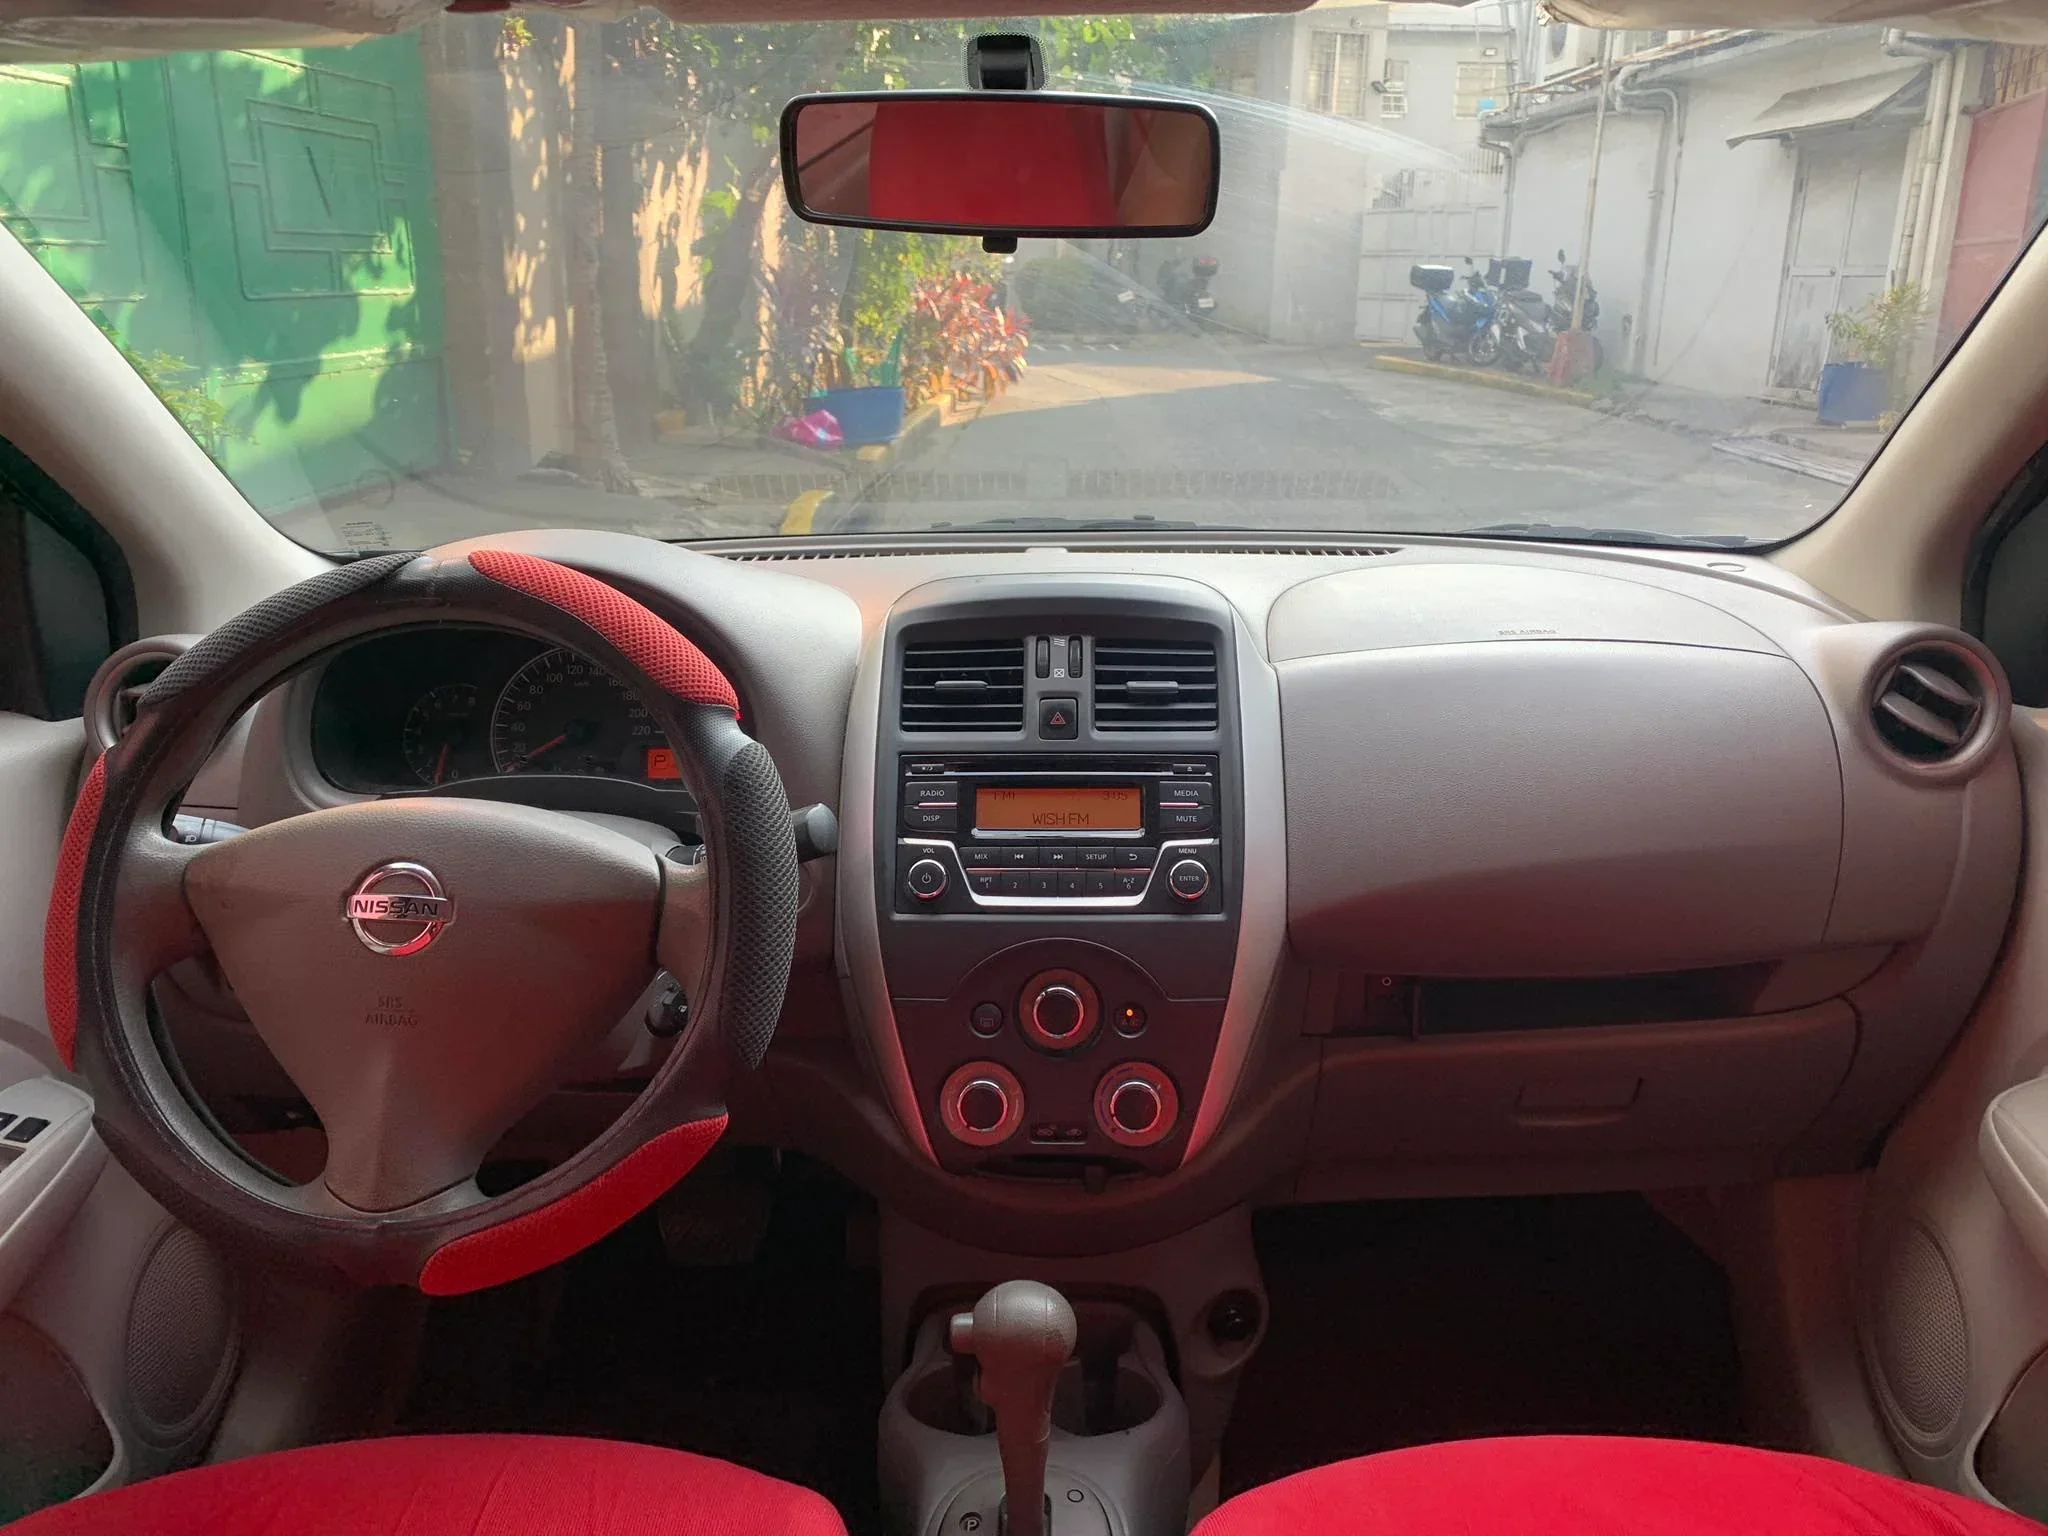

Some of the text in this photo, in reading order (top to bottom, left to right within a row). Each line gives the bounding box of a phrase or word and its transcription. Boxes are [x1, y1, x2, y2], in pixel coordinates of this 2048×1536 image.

[567, 664, 584, 675] 120
[546, 672, 563, 683] 100
[529, 684, 544, 695] 80
[516, 701, 532, 711] 60
[628, 708, 649, 718] 200
[510, 721, 526, 732] 40
[632, 725, 651, 736] 220
[653, 755, 666, 767] P
[920, 789, 945, 797] RADIO
[1174, 789, 1199, 797] MEDIA
[1032, 813, 1090, 825] WISH FM
[353, 899, 439, 916] NISSAN
[377, 995, 403, 1009] SRS
[365, 1013, 418, 1026] AIRBAG
[966, 1519, 979, 1533] P
